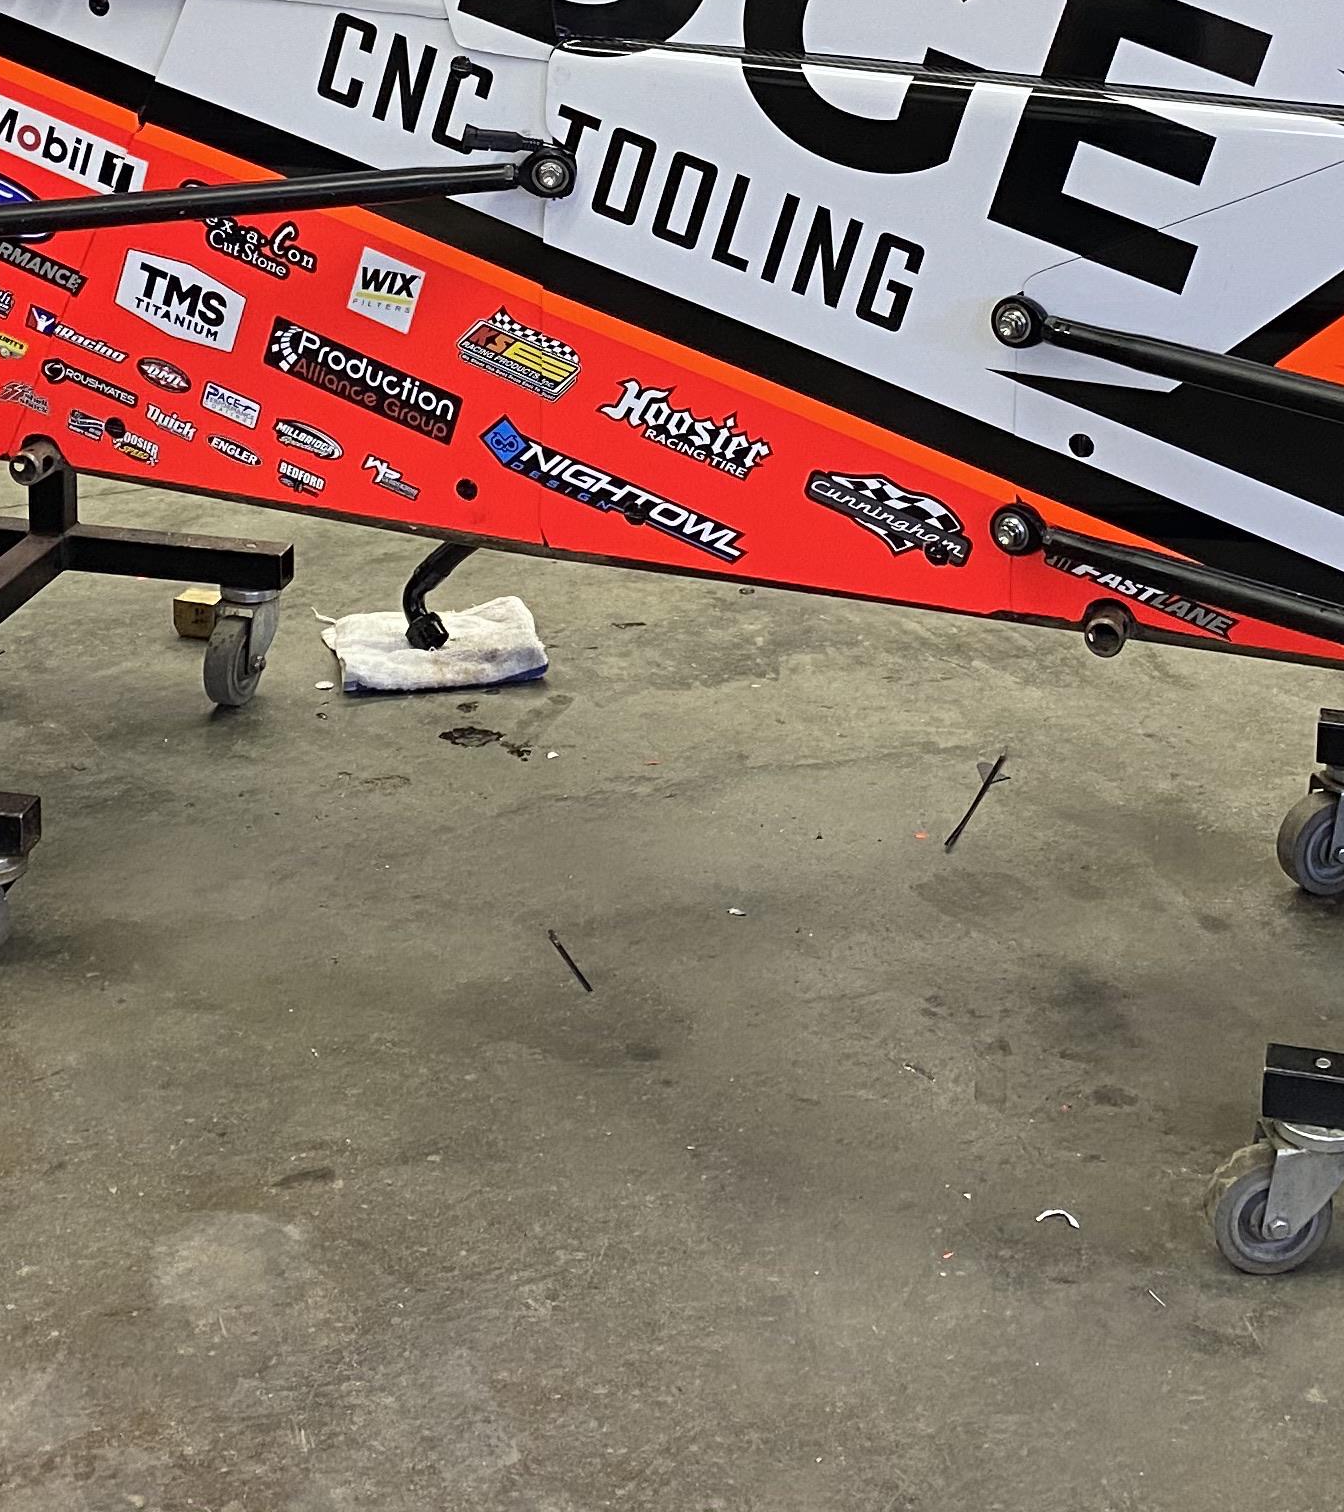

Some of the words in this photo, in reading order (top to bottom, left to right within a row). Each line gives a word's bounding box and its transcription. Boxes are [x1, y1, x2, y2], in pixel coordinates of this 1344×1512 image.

[317, 13, 494, 153] CNC
[553, 104, 926, 333] TOOLING
[209, 230, 241, 256] Cut
[241, 243, 287, 276] Stone
[140, 262, 227, 328] TMS
[360, 266, 418, 299] WIX
[135, 297, 219, 342] TITANIUM
[352, 298, 411, 314] FILTERS
[54, 323, 129, 363] iRacing
[461, 340, 494, 359] RACING
[67, 368, 135, 406] ROUSHYATES
[206, 384, 241, 408] PACE
[299, 331, 454, 421] Production
[294, 361, 378, 404] Alliance
[384, 398, 448, 438] Group
[122, 431, 159, 459] OOSIER
[601, 379, 772, 470] Hoosier
[211, 437, 258, 466] ENGLER
[644, 427, 705, 462] RACING
[710, 456, 748, 478] TIRE
[279, 461, 326, 490] BEDFORD
[511, 460, 611, 512] DESIGN
[519, 441, 748, 558] NIGHTOWL
[810, 479, 964, 561] Cunningham
